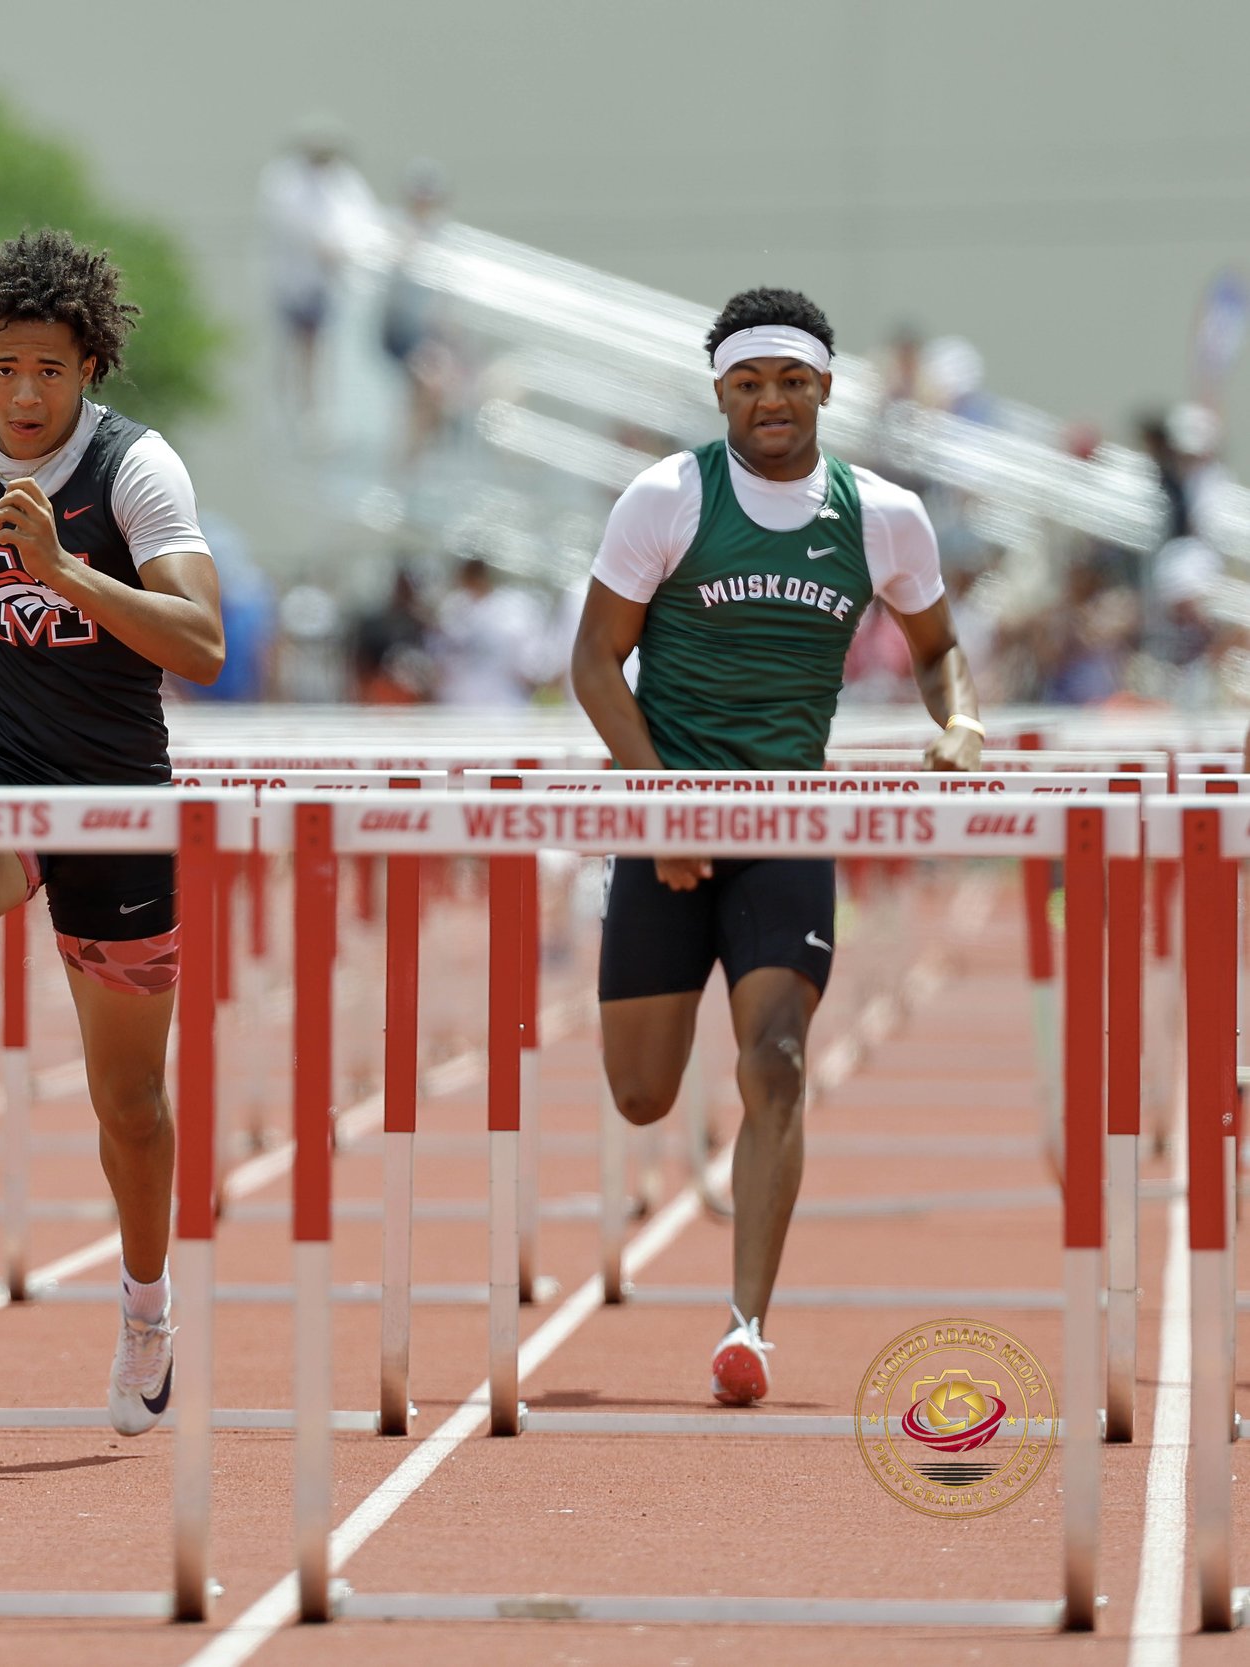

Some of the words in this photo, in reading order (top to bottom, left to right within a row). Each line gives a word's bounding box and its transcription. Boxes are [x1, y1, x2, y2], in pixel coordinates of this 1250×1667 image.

[698, 574, 854, 621] MUSKOGEE
[81, 806, 152, 831] GILL
[359, 809, 431, 833] GILL
[462, 805, 647, 843] WESTERN
[664, 805, 828, 843] HEIGHTS
[843, 806, 936, 844] JETS
[966, 812, 1038, 837] GILL
